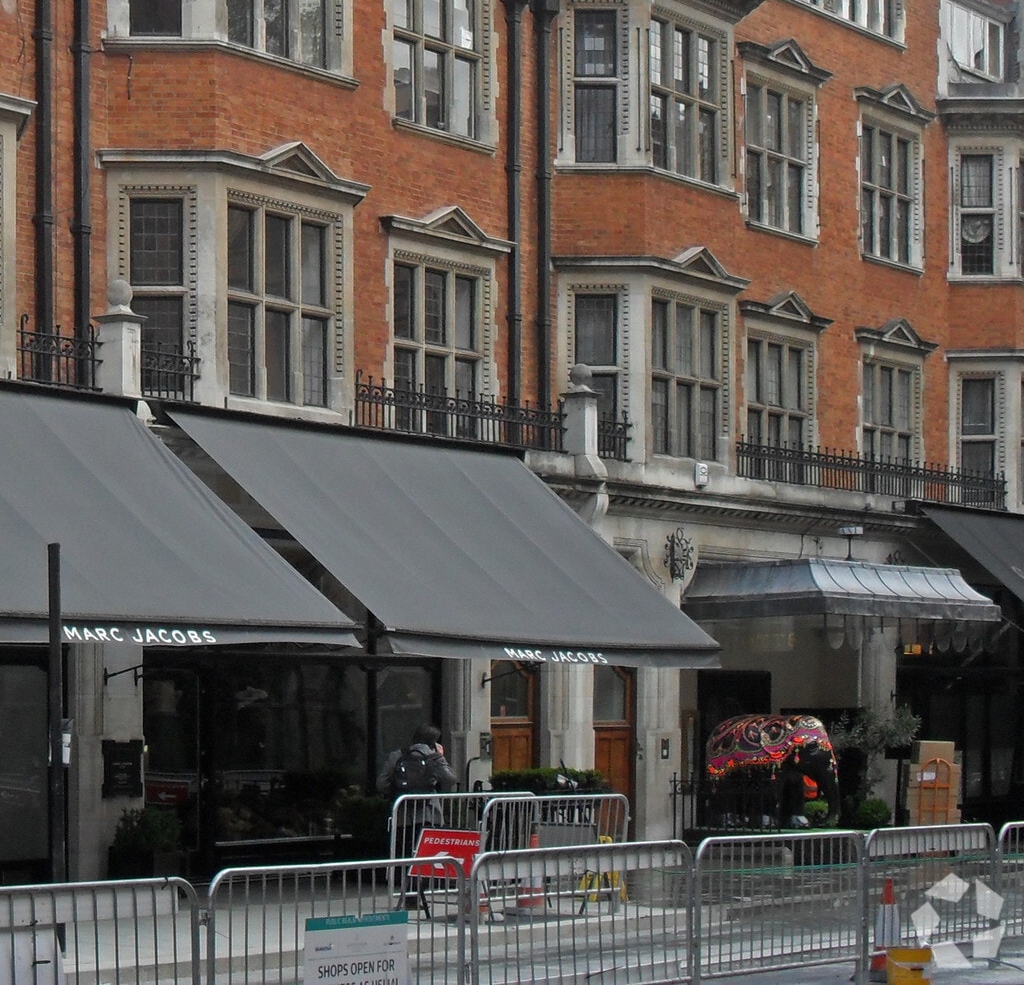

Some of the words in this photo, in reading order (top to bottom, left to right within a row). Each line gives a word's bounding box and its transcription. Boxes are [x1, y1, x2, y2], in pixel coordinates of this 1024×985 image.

[63, 625, 124, 642] MARC
[132, 628, 217, 644] JACOBS
[503, 647, 547, 661] MARC
[551, 651, 608, 664] JACOBS
[423, 836, 481, 847] PEDESTRIANS
[318, 963, 349, 979] SHOPS
[351, 961, 375, 975] OPEN
[377, 959, 395, 972] FOR
